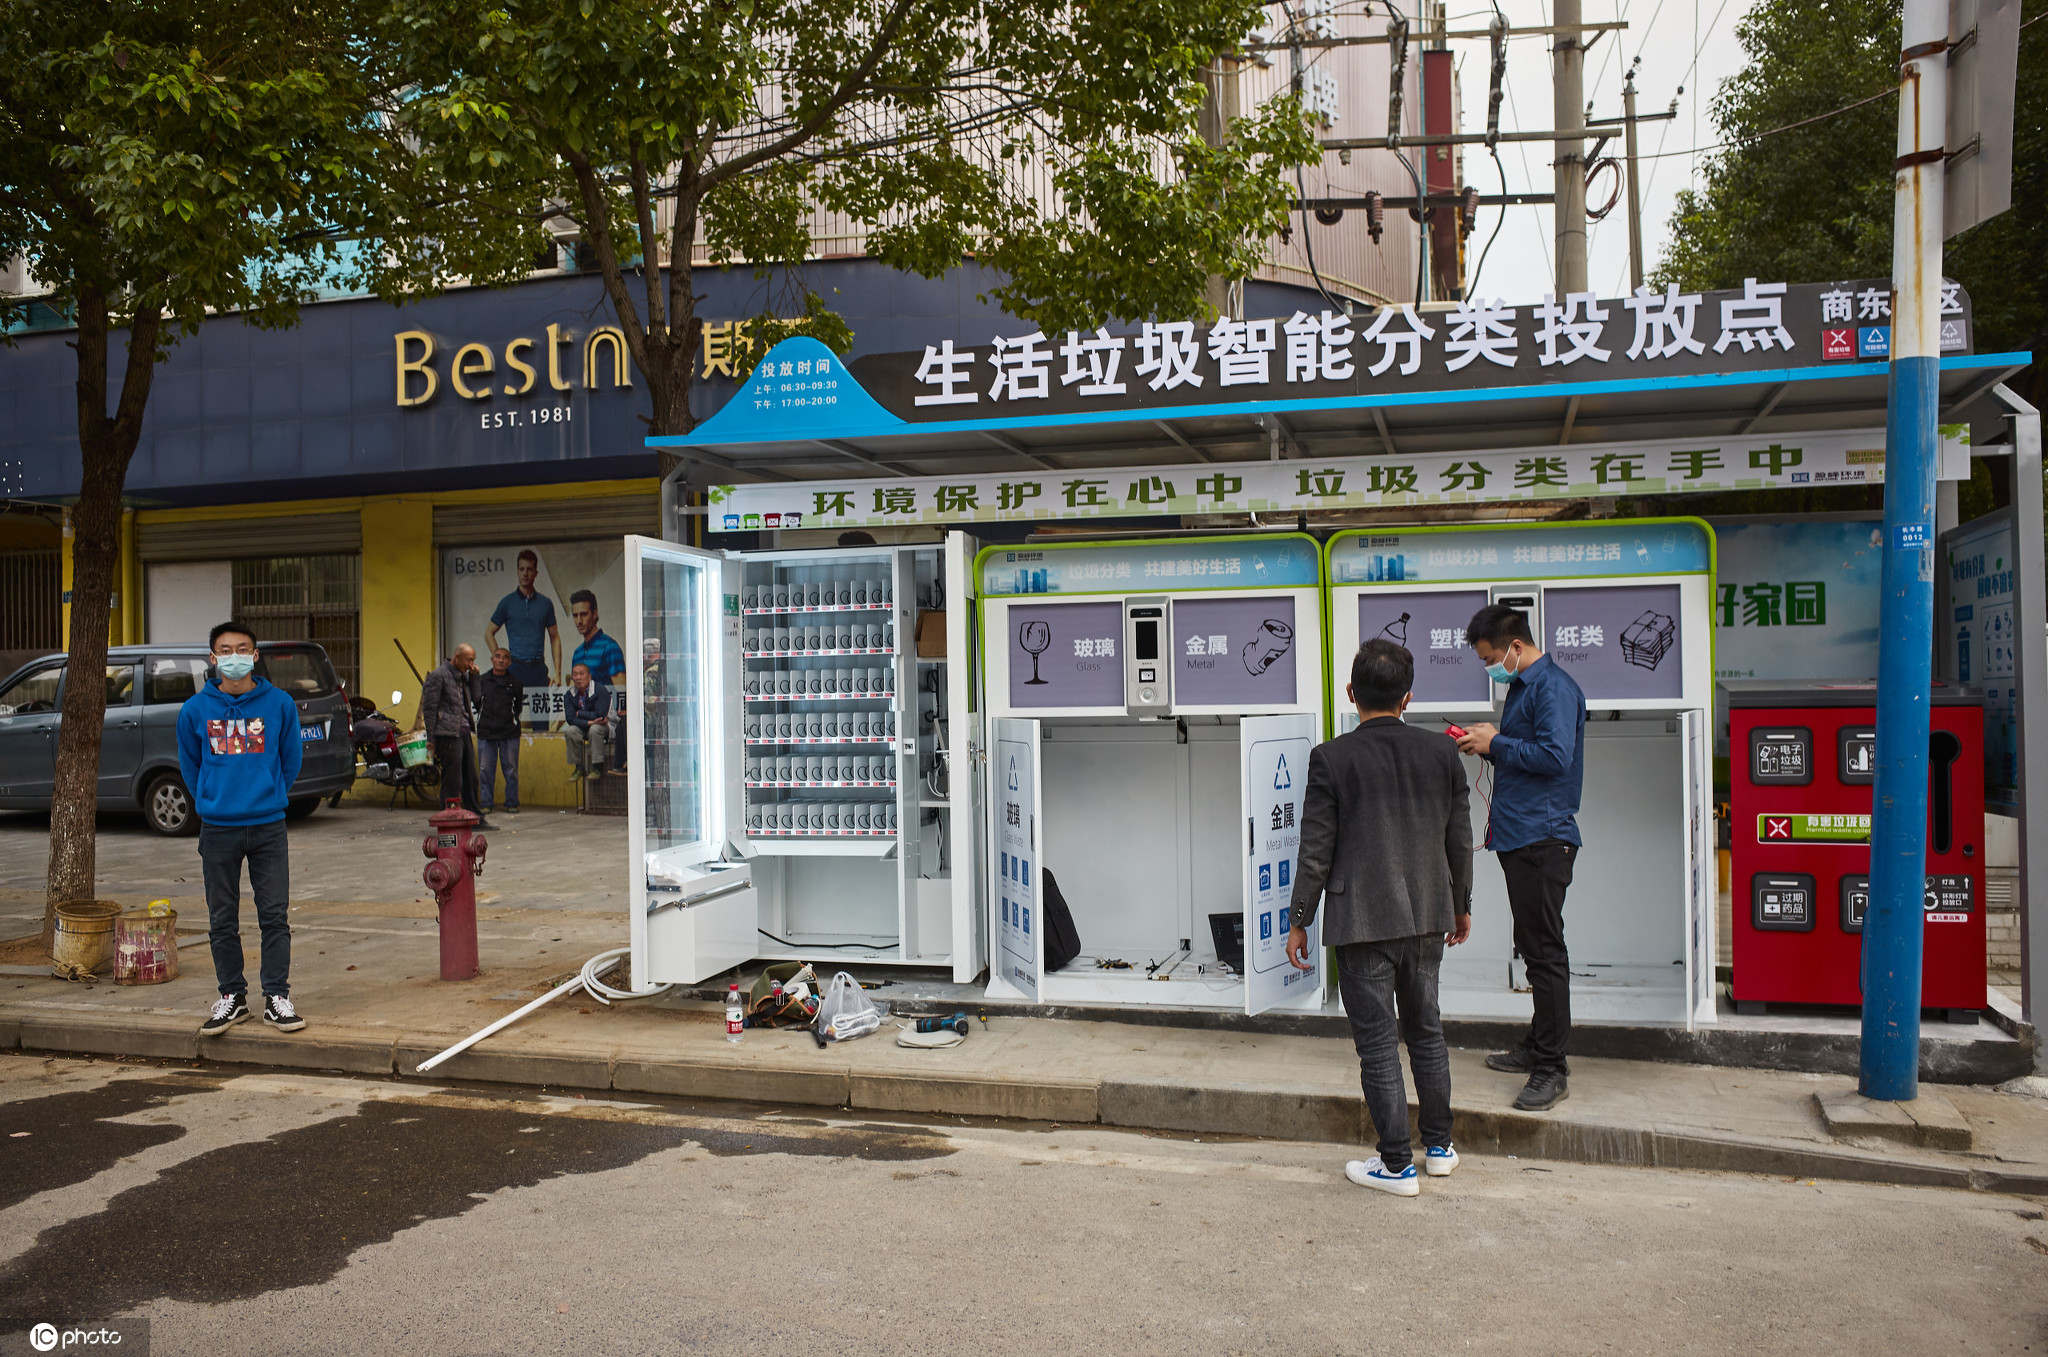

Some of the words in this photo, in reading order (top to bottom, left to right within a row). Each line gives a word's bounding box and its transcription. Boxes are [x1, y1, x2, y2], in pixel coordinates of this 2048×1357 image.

[1820, 283, 1963, 323] 商东区
[914, 277, 1796, 406] 生活垃圾智能分类投放点
[395, 323, 632, 406] Bestn
[761, 359, 831, 378] 投放时间
[481, 411, 523, 429] EST.
[530, 407, 572, 424] 1981
[813, 472, 1243, 516] 环境保护在心中
[1295, 443, 1803, 496] 垃圾分类在手中
[1902, 533, 1923, 542] 0012
[1428, 547, 1498, 566] 垃圾分类
[1512, 543, 1621, 563] 共建美好生活
[455, 556, 505, 574] Bestn
[1068, 562, 1131, 580] 垃圾分类
[1144, 558, 1241, 578] 共建美好生活
[1715, 581, 1826, 627] 好家园
[1186, 635, 1228, 655] 金属
[1555, 625, 1604, 647] 纸类
[1074, 638, 1115, 657] 玻璃
[1557, 651, 1589, 662] Paper
[1076, 661, 1101, 672] Glass
[1187, 659, 1215, 669] Metal
[1430, 655, 1463, 665] Plastic
[1780, 744, 1801, 755] 电子
[1780, 755, 1802, 766] 垃圾
[1006, 801, 1021, 829] 玻璃
[1271, 802, 1295, 831] 金属
[1266, 839, 1282, 851] Metal
[1284, 834, 1300, 847] Waste
[1782, 892, 1803, 903] 过期
[1782, 903, 1803, 914] 药品
